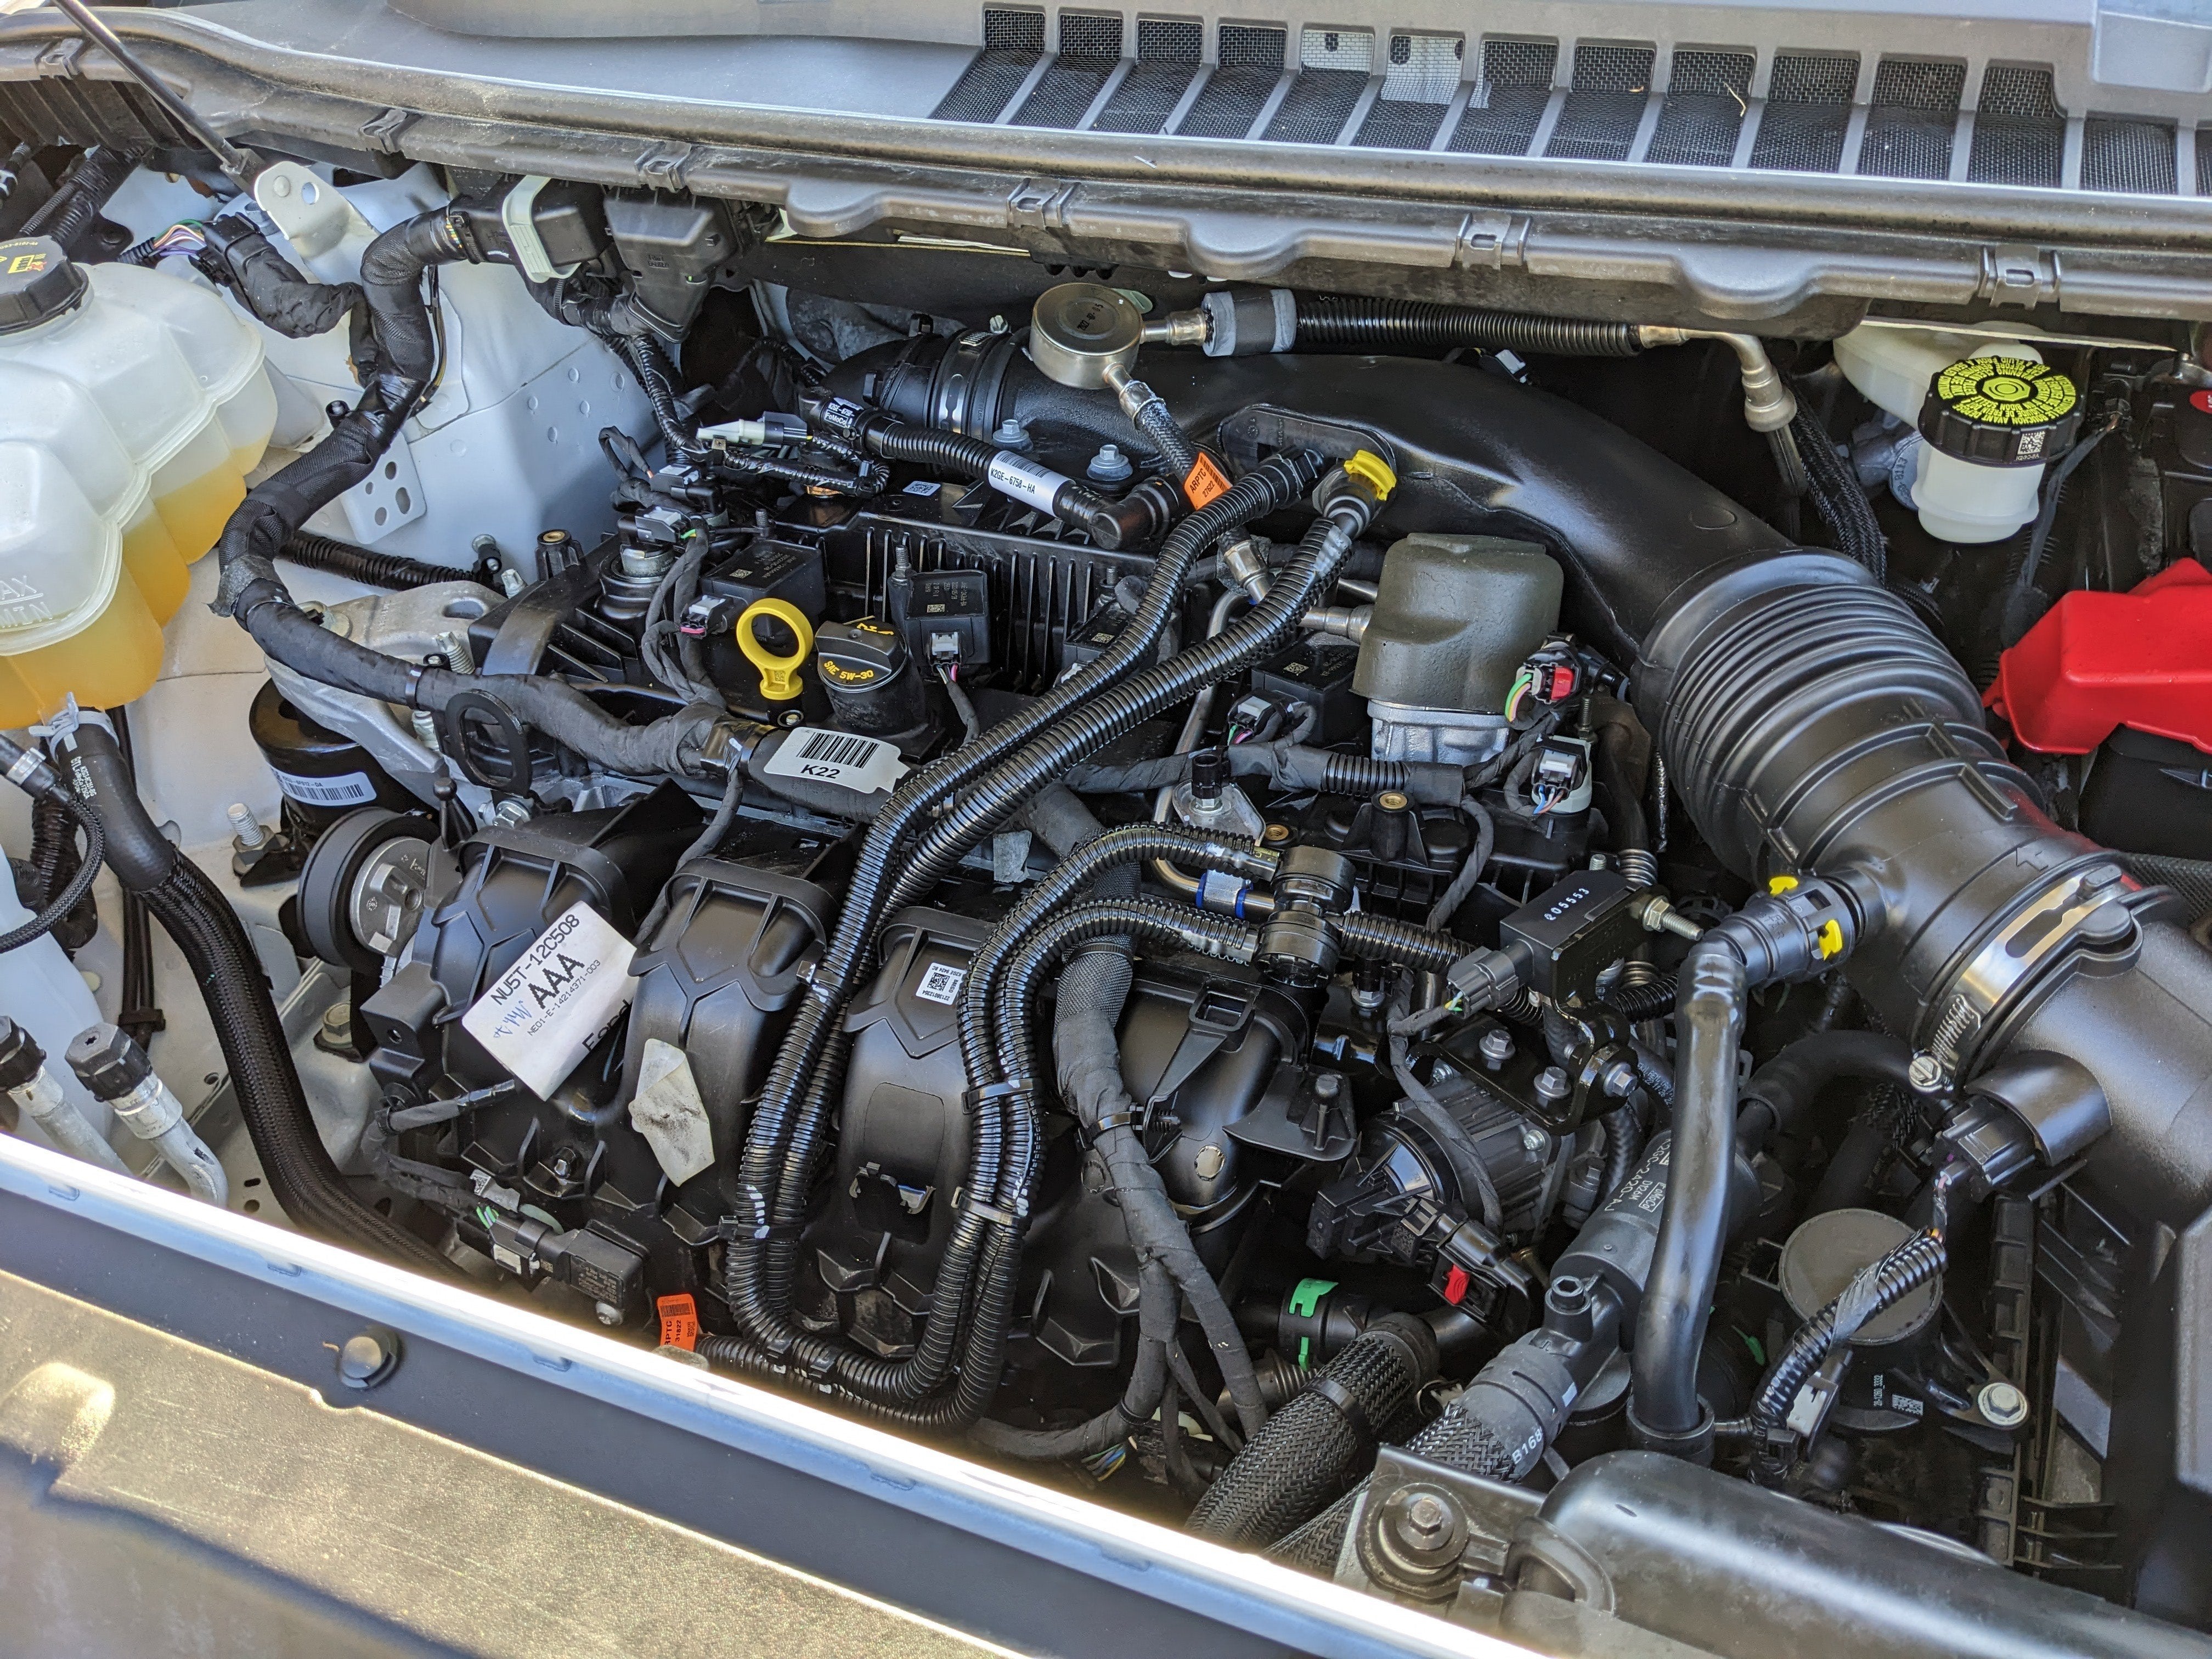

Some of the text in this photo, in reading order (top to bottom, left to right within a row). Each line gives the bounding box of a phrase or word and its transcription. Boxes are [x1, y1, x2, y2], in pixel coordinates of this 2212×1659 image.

[990, 468, 1035, 494] K2GE-6758-HA
[1190, 468, 1206, 494] ARPTC
[824, 661, 874, 680] SAE 5W-30
[800, 764, 840, 779] K22
[1544, 888, 1589, 920] 205553
[490, 914, 580, 1006] NU5T-12C508
[528, 953, 585, 1009] AAA
[1512, 1427, 1542, 1464] B168
